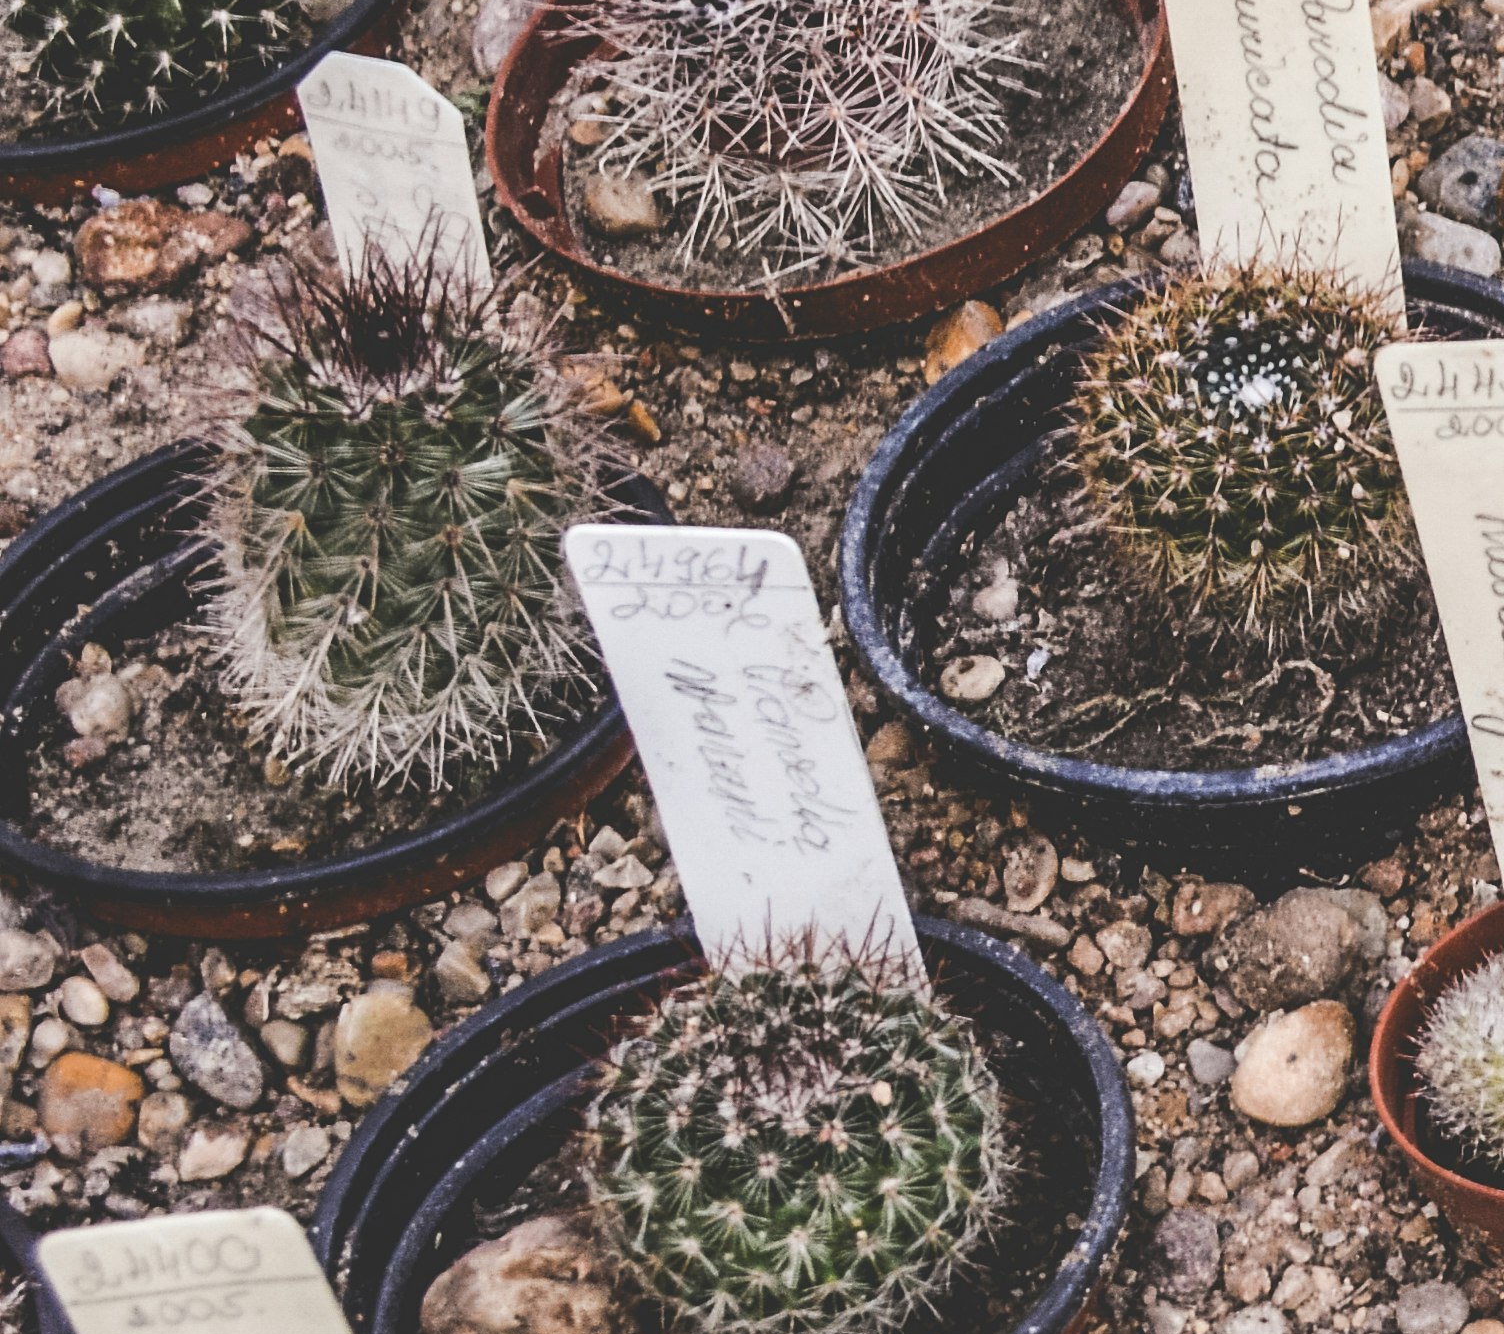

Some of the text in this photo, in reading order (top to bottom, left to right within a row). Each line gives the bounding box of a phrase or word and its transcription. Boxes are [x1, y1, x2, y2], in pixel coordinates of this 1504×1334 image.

[582, 536, 780, 591] 24964
[606, 583, 773, 637] 2006
[739, 662, 859, 856] Parodia
[69, 1232, 264, 1297] 24400
